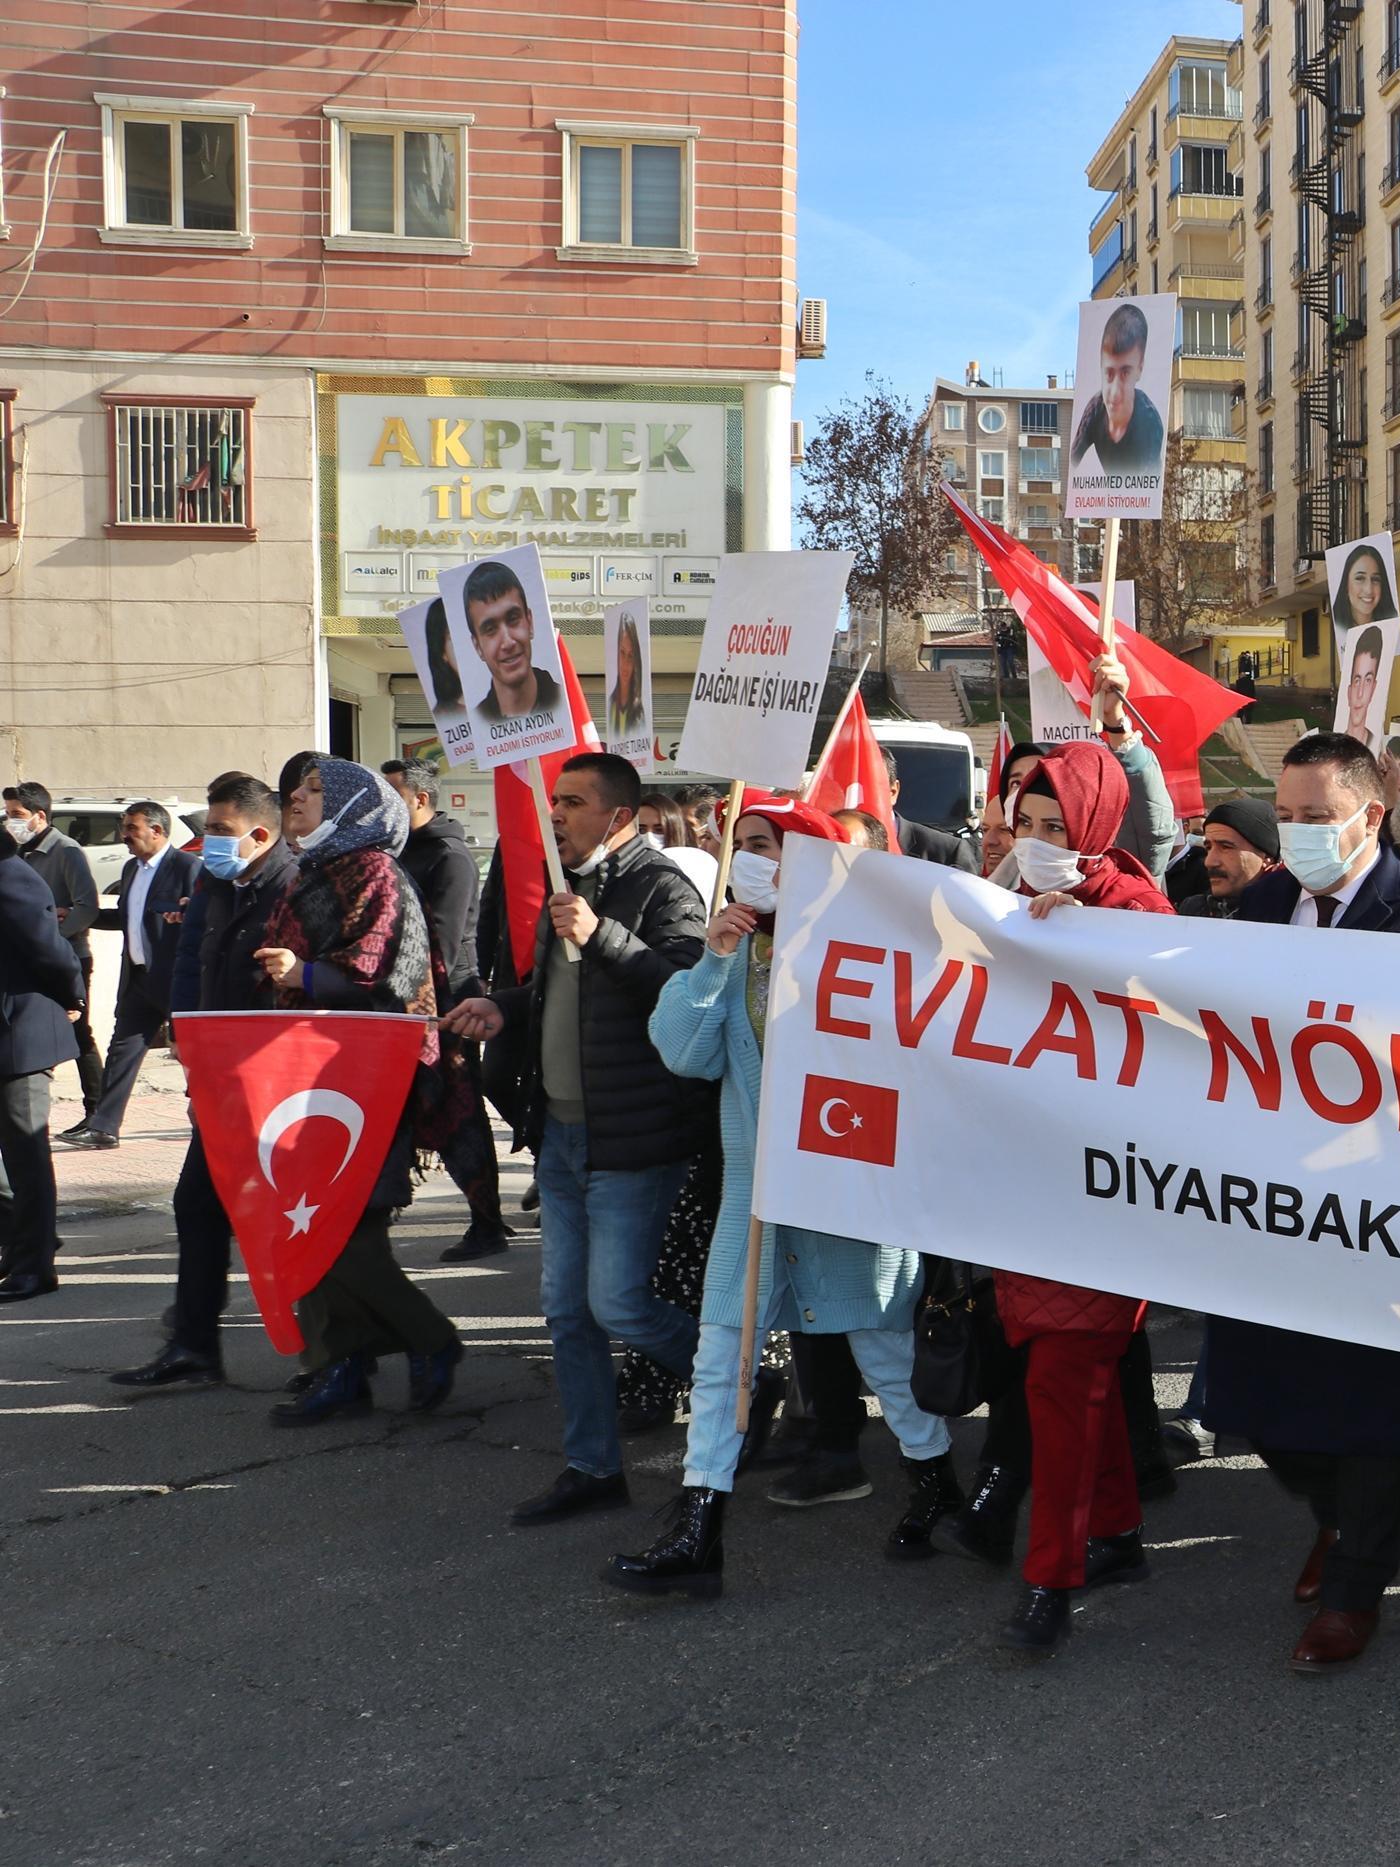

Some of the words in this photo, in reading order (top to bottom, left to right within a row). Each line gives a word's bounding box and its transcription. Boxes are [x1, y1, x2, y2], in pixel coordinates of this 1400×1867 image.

[368, 416, 695, 472] AKPETEK
[1073, 475, 1122, 489] MUHAMMED
[1125, 475, 1160, 489] CANBEY
[430, 475, 637, 522] TİCARET
[1075, 496, 1105, 508] EVLADIMI
[1107, 494, 1151, 508] İSTİYORUM!
[377, 525, 461, 548] İNŞAAT
[467, 530, 518, 546] YAPI
[527, 529, 687, 548] MALZEMELERİ
[727, 617, 792, 662] ÇOCUĞUN
[694, 667, 740, 706] DAĞDA
[740, 676, 760, 707] NE
[758, 670, 781, 718] İŞİ
[779, 679, 819, 714] VAR!
[490, 720, 523, 740] ÖZKAN
[525, 711, 555, 731] AYDIN
[1043, 723, 1081, 740] MACİT
[453, 742, 475, 756] EVLAD
[486, 739, 521, 757] EVLADIMI
[521, 728, 565, 748] İSTİYORUM!
[815, 940, 1161, 1088] EVLAT
